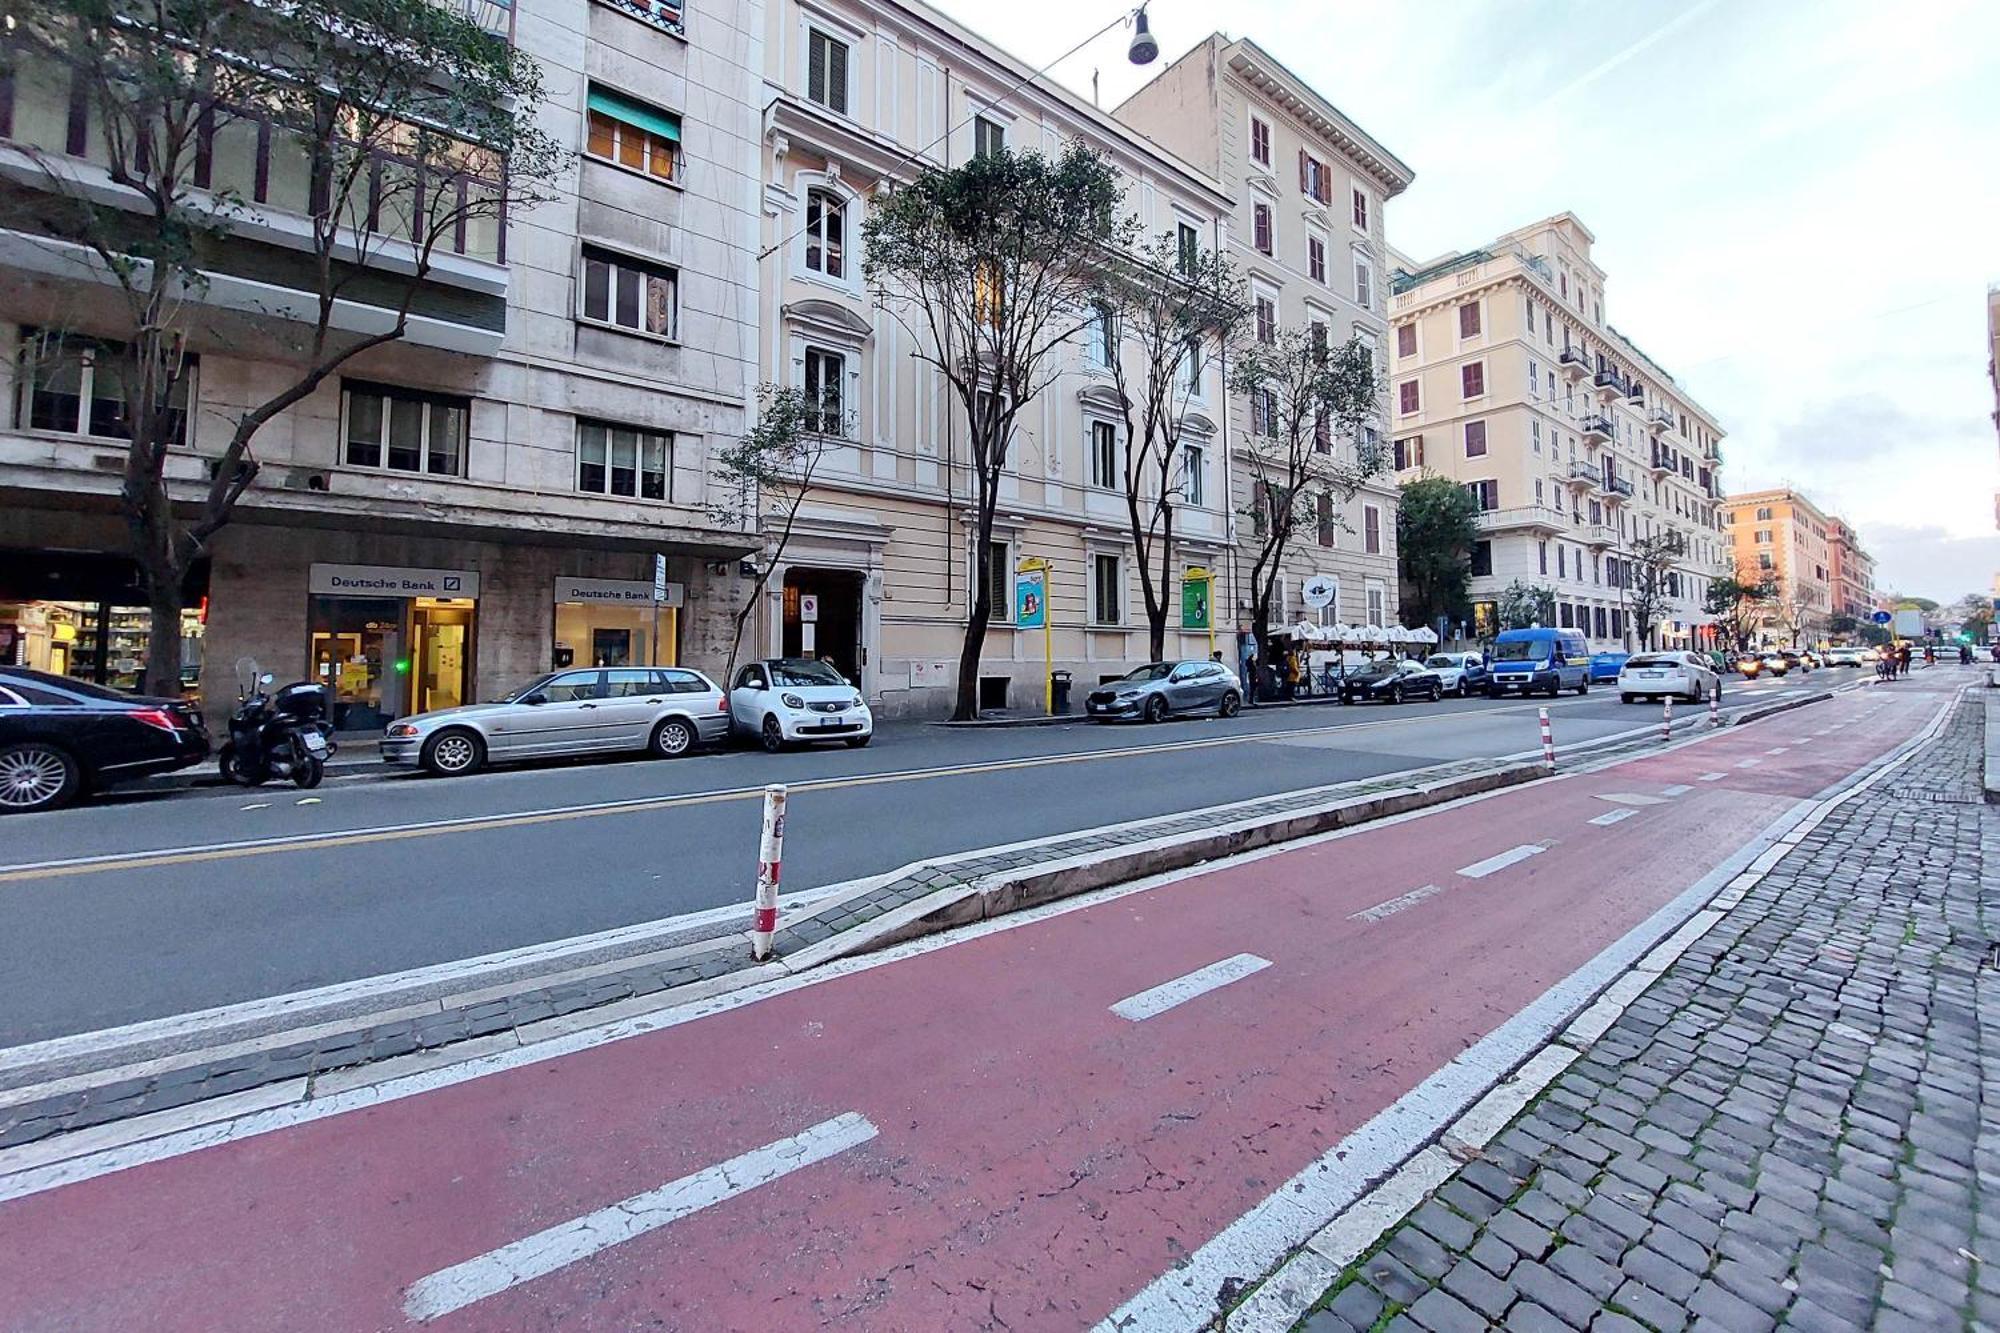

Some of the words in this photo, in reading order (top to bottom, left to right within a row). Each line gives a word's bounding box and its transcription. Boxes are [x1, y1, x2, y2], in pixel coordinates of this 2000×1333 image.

[331, 576, 397, 589] Deutsche
[402, 579, 435, 590] Bank
[571, 588, 621, 599] Deutsche
[624, 590, 650, 600] Bank
